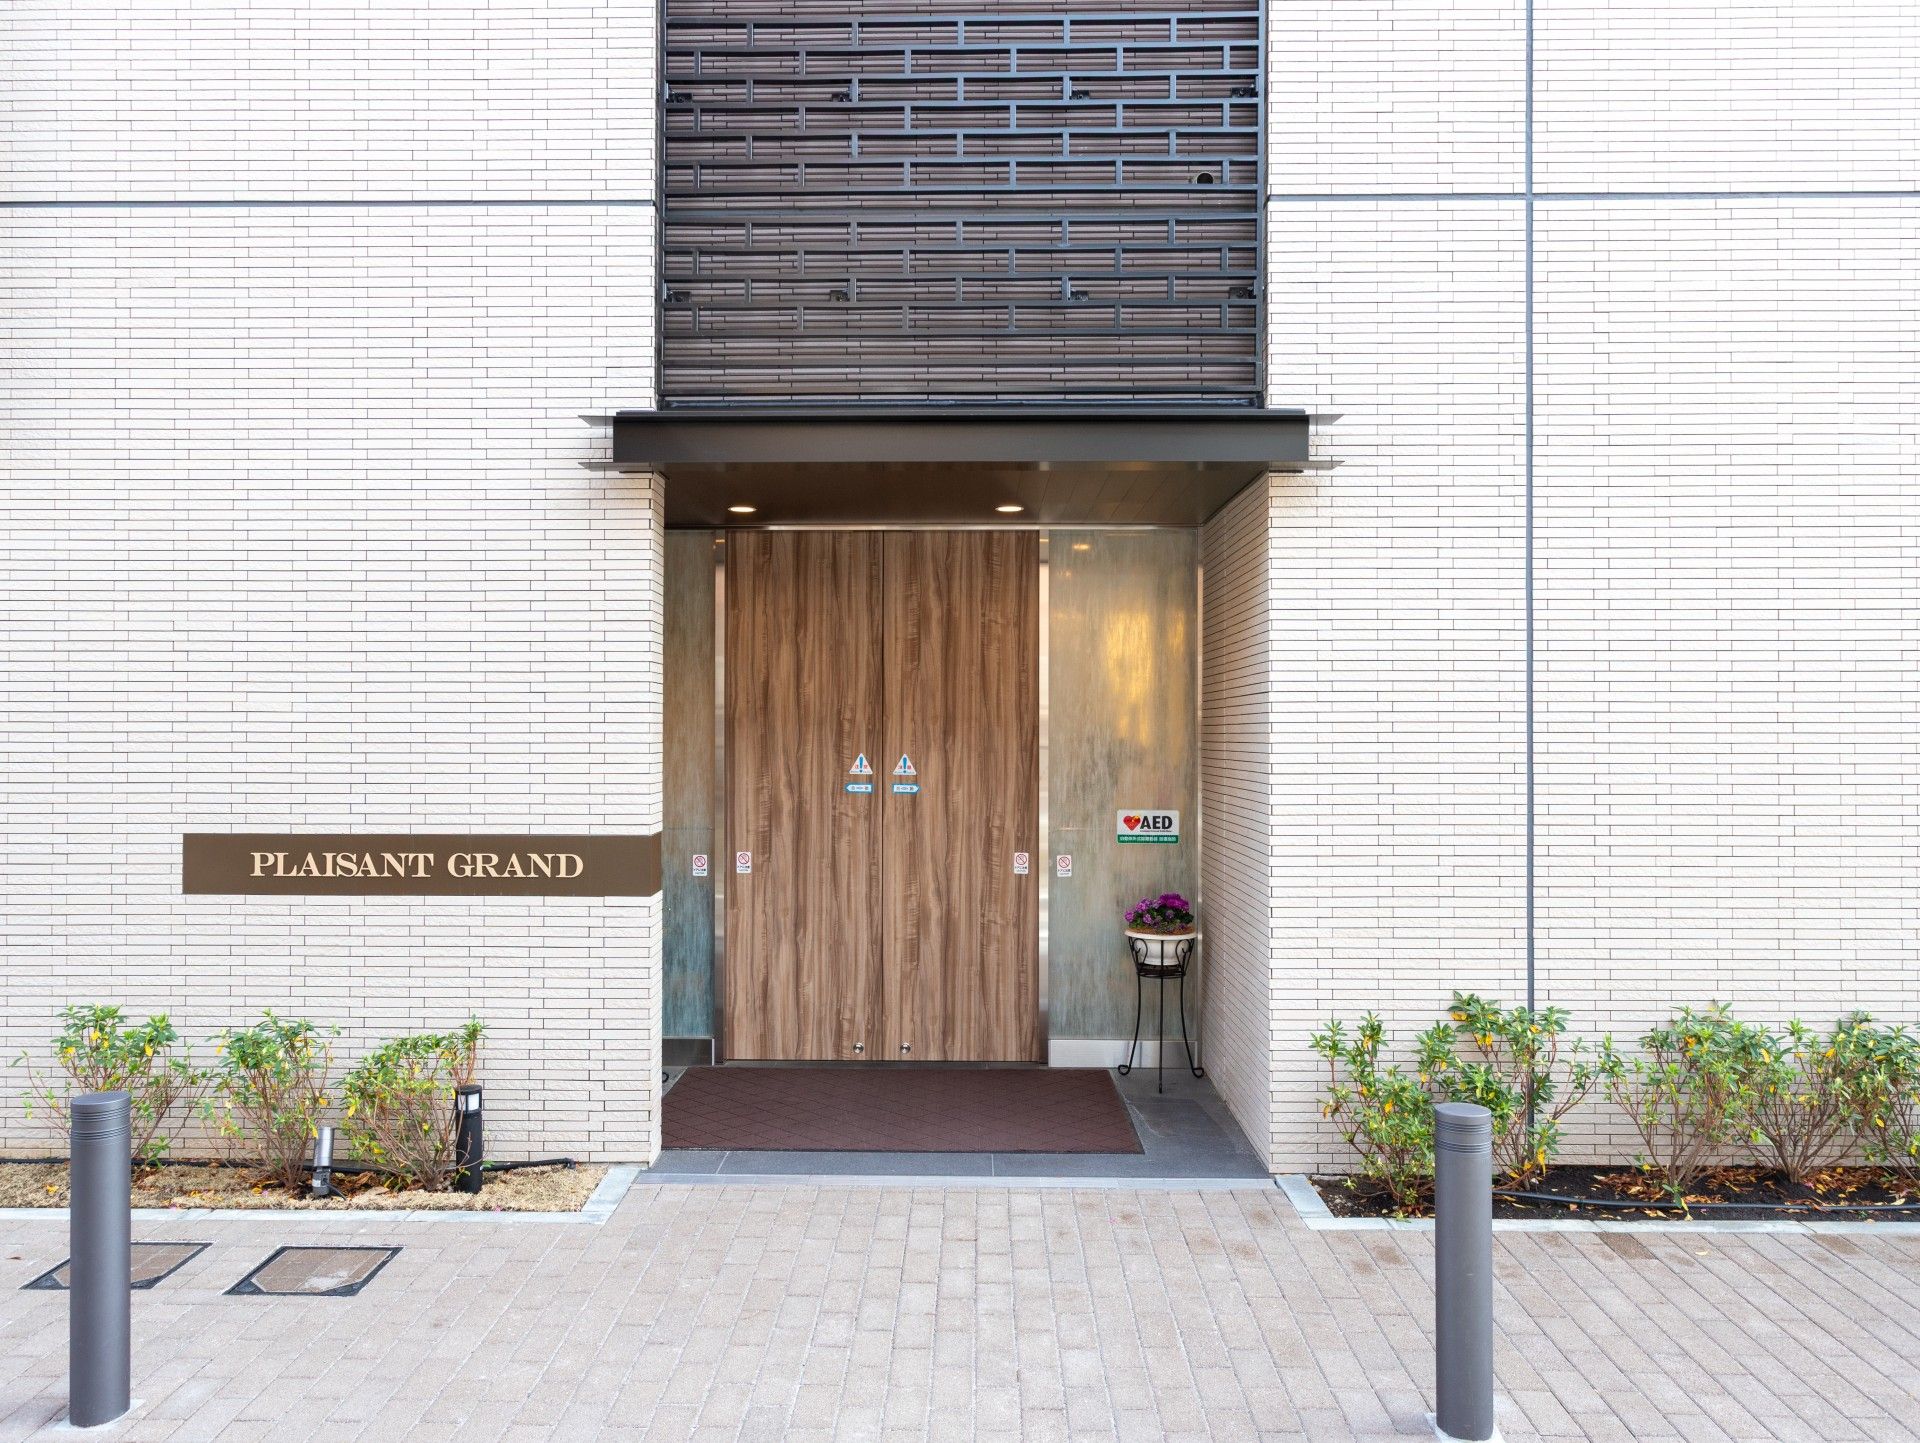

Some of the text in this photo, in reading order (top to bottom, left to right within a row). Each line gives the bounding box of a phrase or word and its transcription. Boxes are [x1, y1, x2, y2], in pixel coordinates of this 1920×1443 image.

[1140, 815, 1173, 830] AED
[250, 852, 584, 878] PLAISANT GRAND
